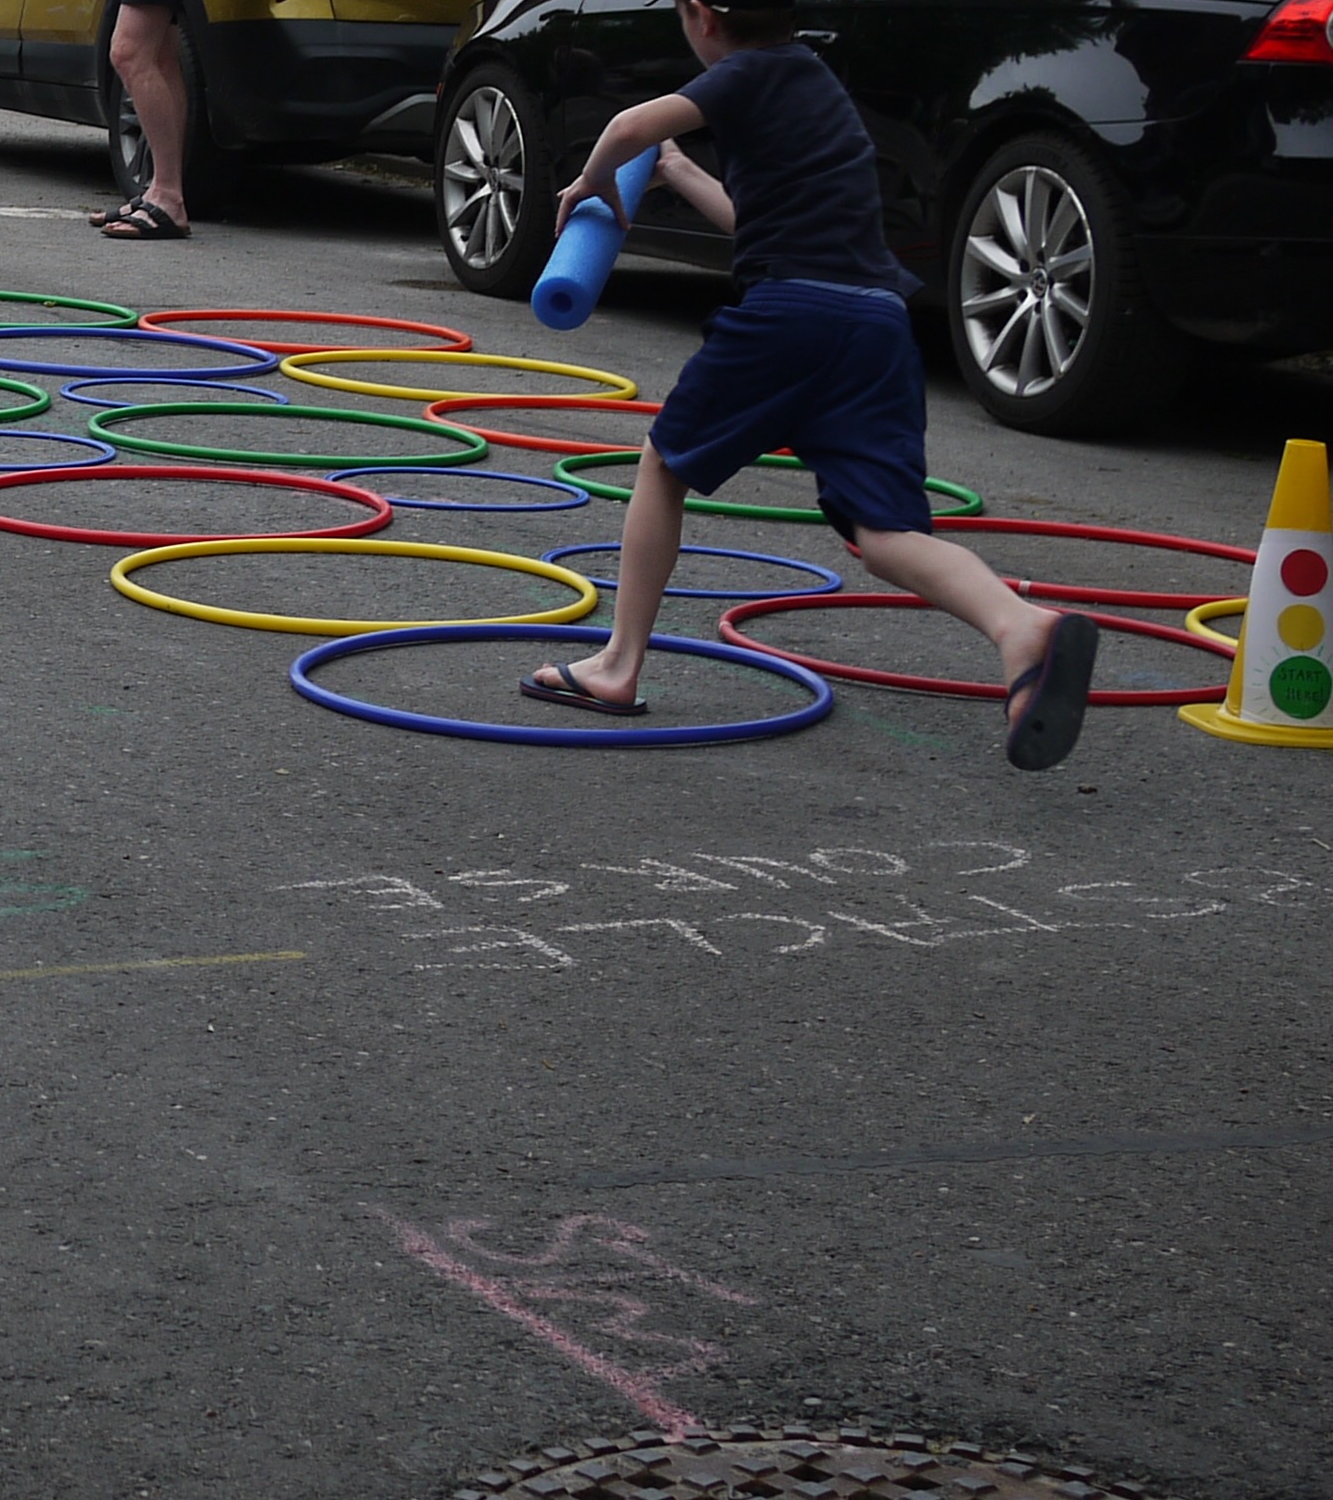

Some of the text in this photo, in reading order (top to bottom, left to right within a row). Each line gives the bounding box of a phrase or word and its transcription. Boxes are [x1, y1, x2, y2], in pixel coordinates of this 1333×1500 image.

[1278, 667, 1323, 683] START
[1286, 687, 1325, 703] HERE!
[400, 866, 1333, 968] BSTACLE
